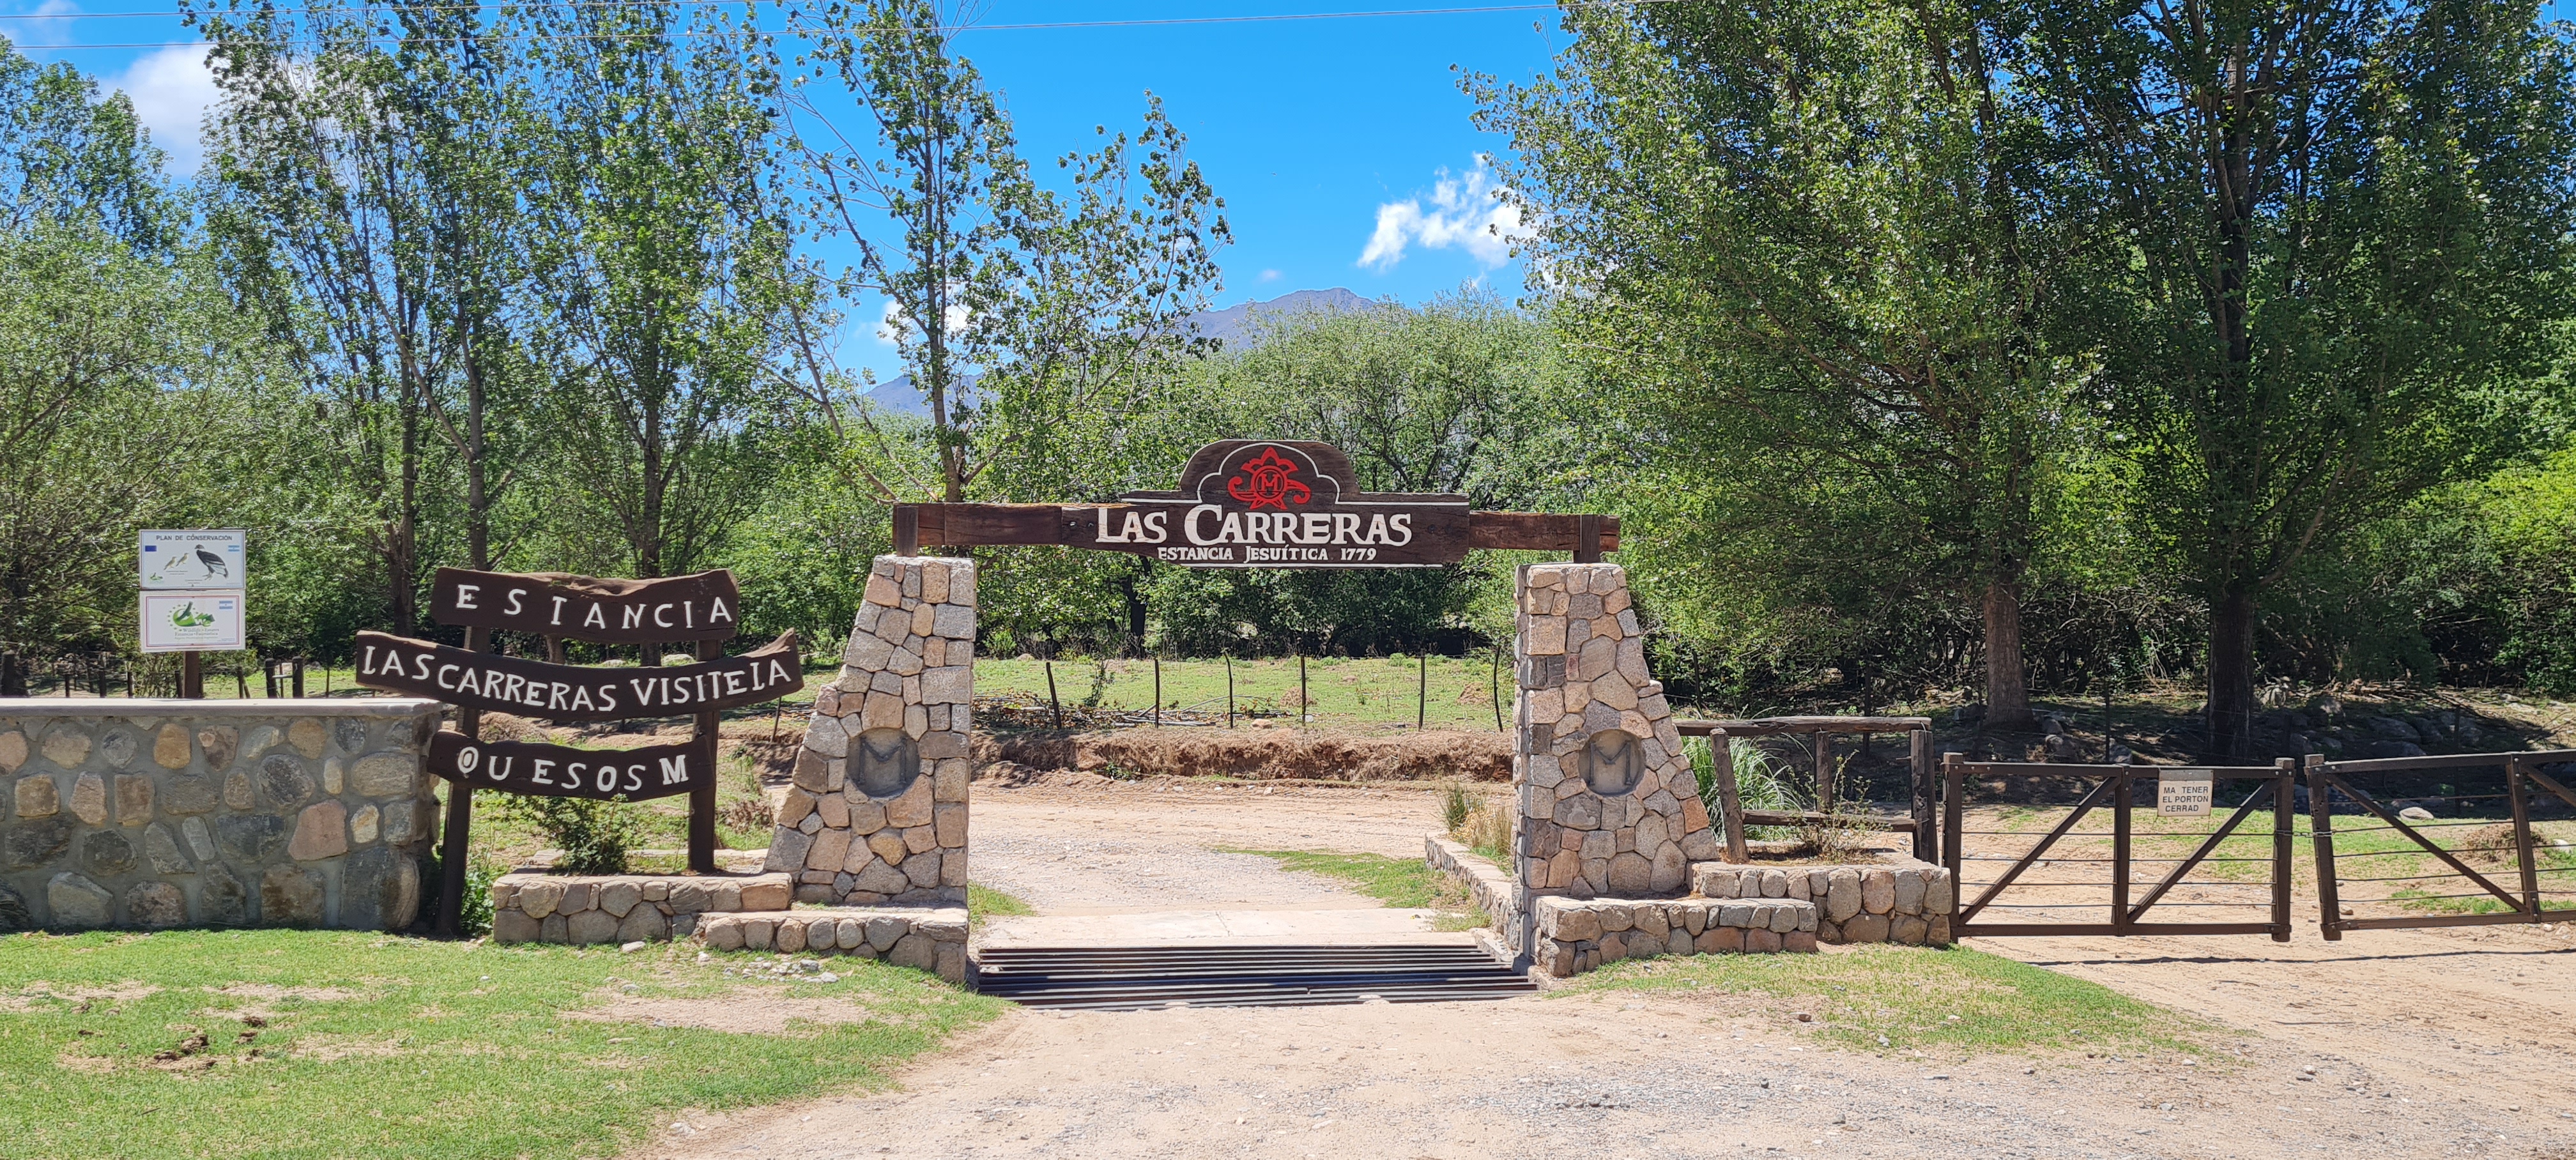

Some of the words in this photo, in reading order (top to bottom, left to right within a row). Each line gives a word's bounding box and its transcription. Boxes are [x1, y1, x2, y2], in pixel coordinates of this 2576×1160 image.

[1096, 507, 1167, 543] LAS
[1184, 504, 1412, 546] CARRERAS
[1158, 547, 1234, 561] ESTANCIA
[1244, 545, 1329, 563] JESUÍTICA
[1340, 547, 1377, 561] 1779
[456, 584, 733, 630] ESTANCIA
